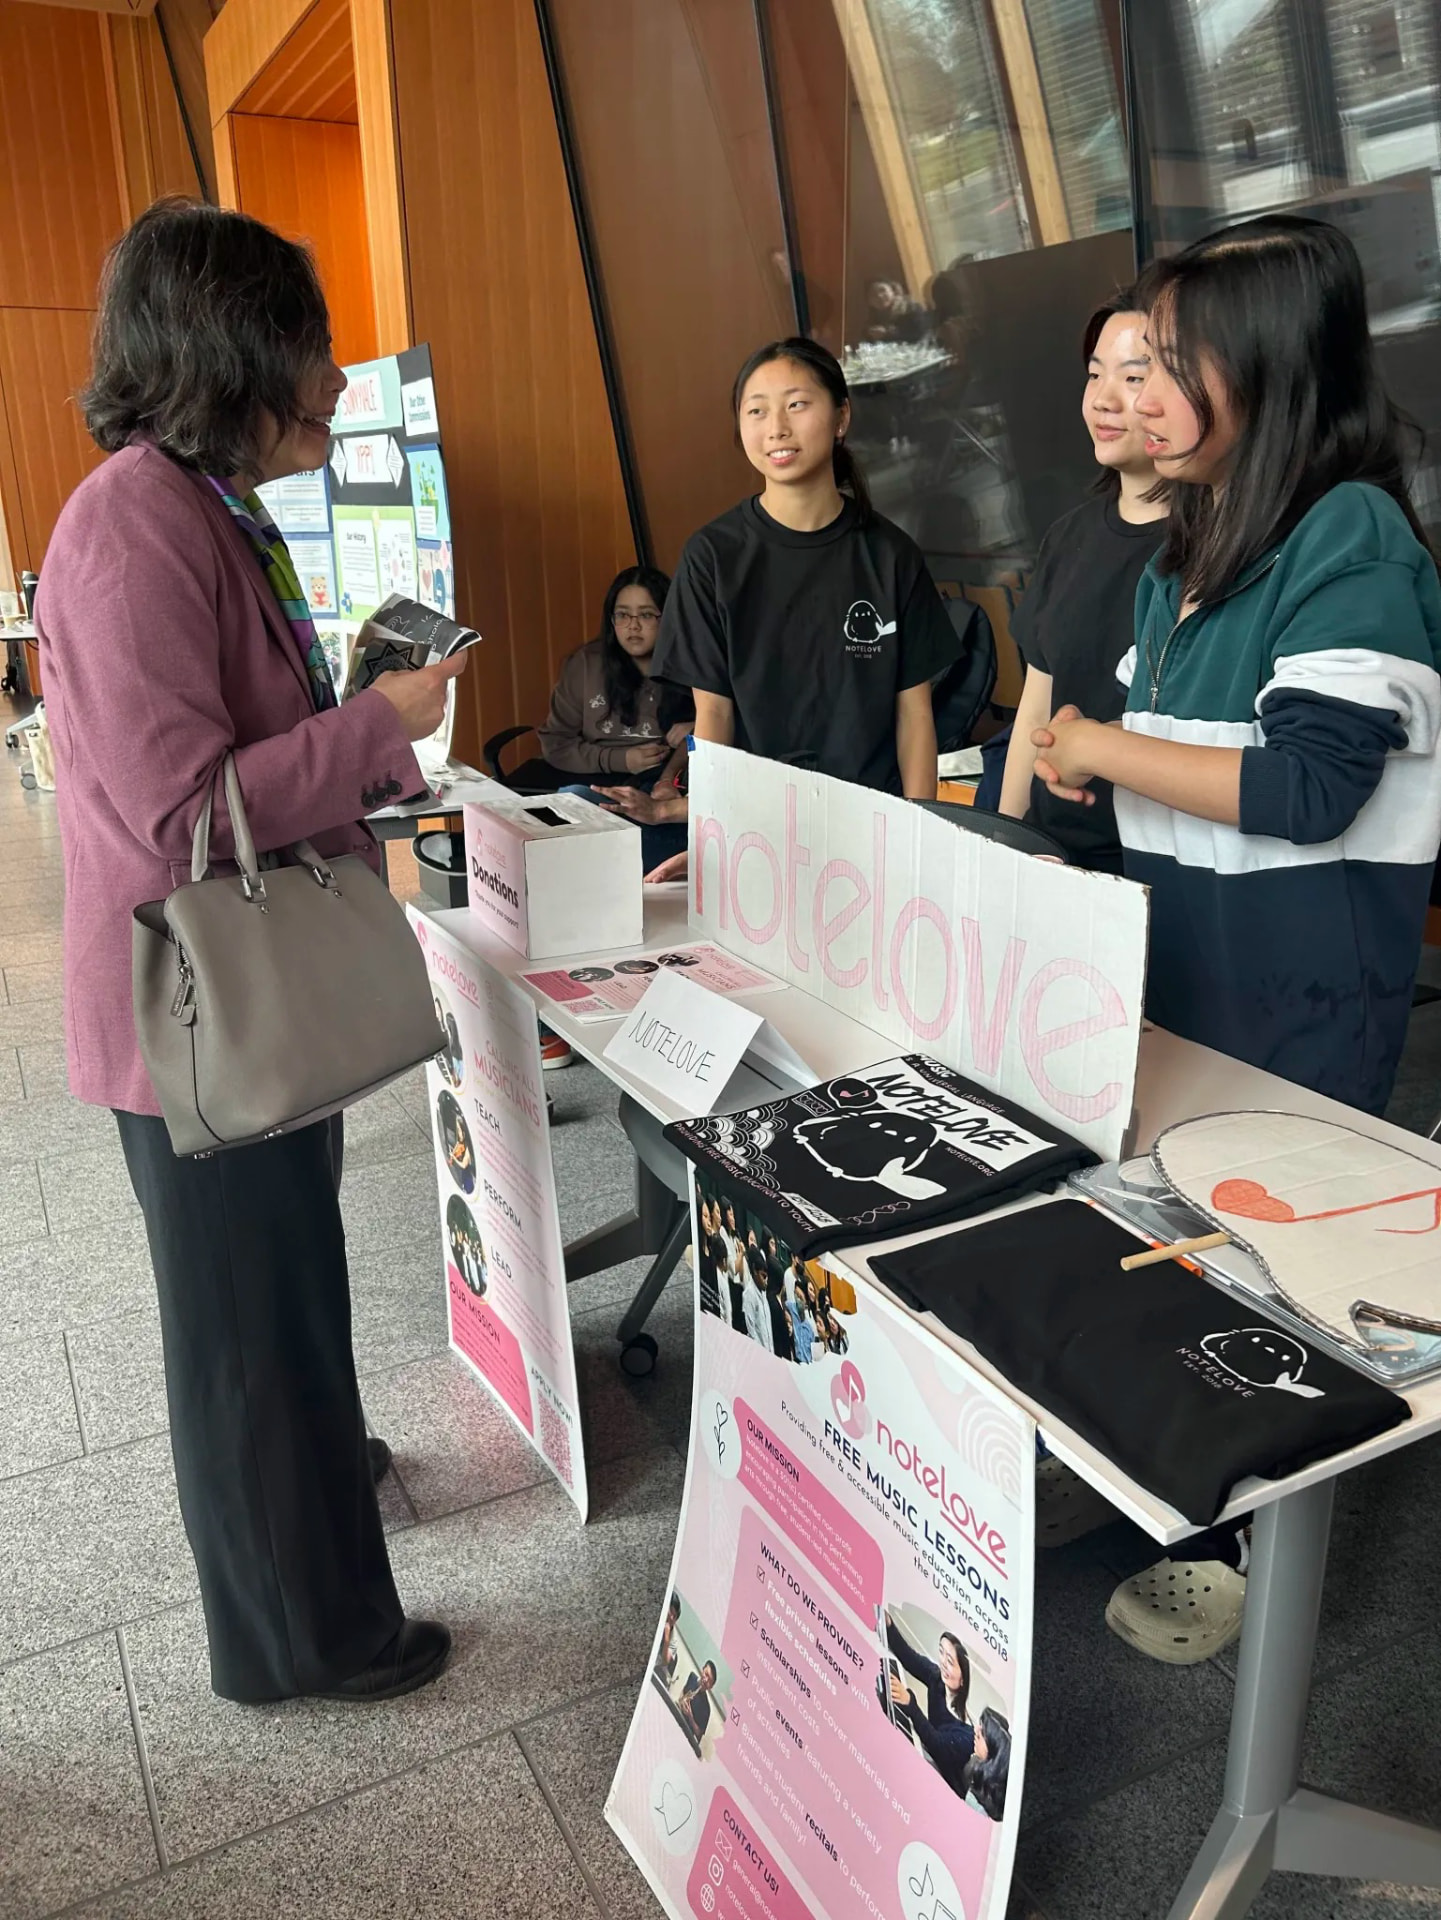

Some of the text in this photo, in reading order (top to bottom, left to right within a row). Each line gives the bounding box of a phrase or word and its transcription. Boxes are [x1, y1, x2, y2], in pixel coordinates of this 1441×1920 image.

[845, 645, 882, 653] NOTELOVE
[472, 855, 519, 909] Donations
[432, 949, 480, 1004] notelove
[696, 784, 1128, 1124] notelove
[474, 1048, 541, 1127] MUSICIANS
[629, 1010, 716, 1083] NOTELOVE
[915, 1053, 957, 1078] MUSIC
[866, 1073, 1031, 1151] NOTELOVE
[919, 1068, 960, 1094] UNIVERSAL
[961, 1092, 1006, 1114] LANGUAGE
[703, 1145, 721, 1160] FREE
[719, 1158, 743, 1178] MUSIC
[777, 1198, 790, 1208] TO
[788, 1208, 816, 1233] YOUTH
[945, 1146, 996, 1177] NOTELOVE.ORG
[450, 1281, 501, 1345] OUR MISSION
[1175, 1347, 1256, 1398] NOTELOVE
[1201, 1374, 1222, 1389] 2018
[747, 1419, 799, 1482] OUR MISSION
[777, 1485, 812, 1527] participation
[818, 1529, 829, 1546] the
[829, 1541, 863, 1586] performing
[781, 1400, 1009, 1645] Providing free & accessible music education across
[797, 1492, 821, 1522] certified
[824, 1419, 1010, 1621] FREE MUSIC LESSONS
[877, 1419, 1007, 1572] notelove
[822, 1551, 841, 1576] music
[760, 1541, 864, 1672] WHAT DO WE PROVIDE?
[764, 1599, 837, 1696] flexible schedules
[767, 1579, 870, 1711] Free private lessons with
[914, 1557, 1008, 1662] the U.S. since 2018
[748, 1698, 791, 1760] of activities
[756, 1650, 820, 1736] instrument costs
[760, 1627, 911, 1825] Scholarships to cover materials and
[736, 1743, 808, 1846] friends and family!
[752, 1674, 882, 1855] Public events featuring a variety
[723, 1808, 780, 1896] CONTACT US!
[741, 1723, 886, 1920] Biannual student recitals to perform
